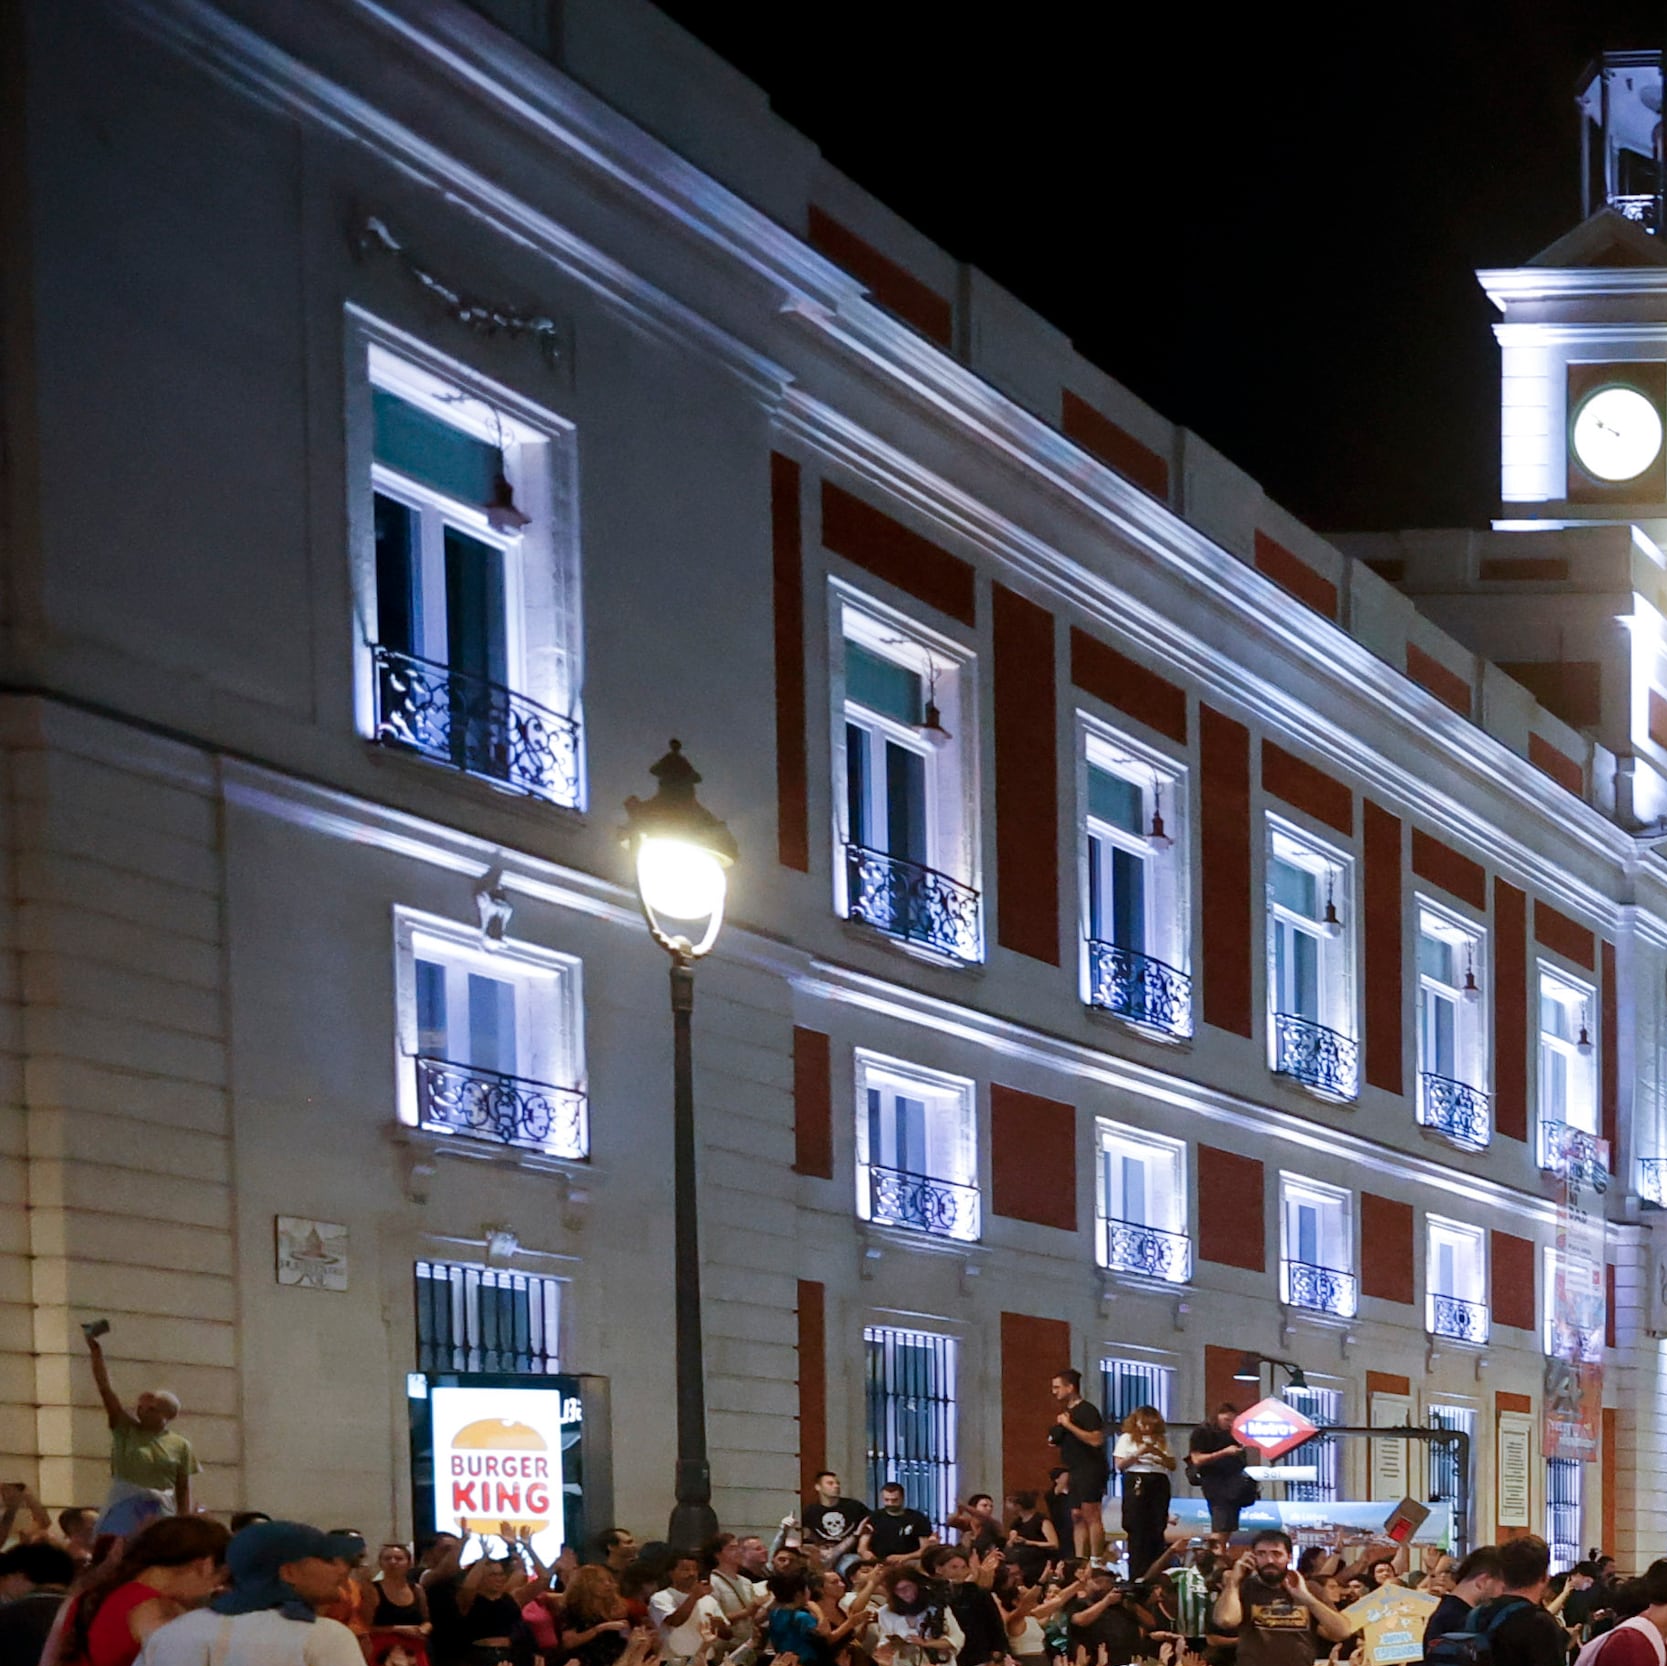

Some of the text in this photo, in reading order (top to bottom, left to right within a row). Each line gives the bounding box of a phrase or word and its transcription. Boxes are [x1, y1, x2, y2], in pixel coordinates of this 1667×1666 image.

[1248, 1421, 1289, 1436] Metro
[450, 1455, 549, 1478] BURGER
[452, 1480, 551, 1514] KING
